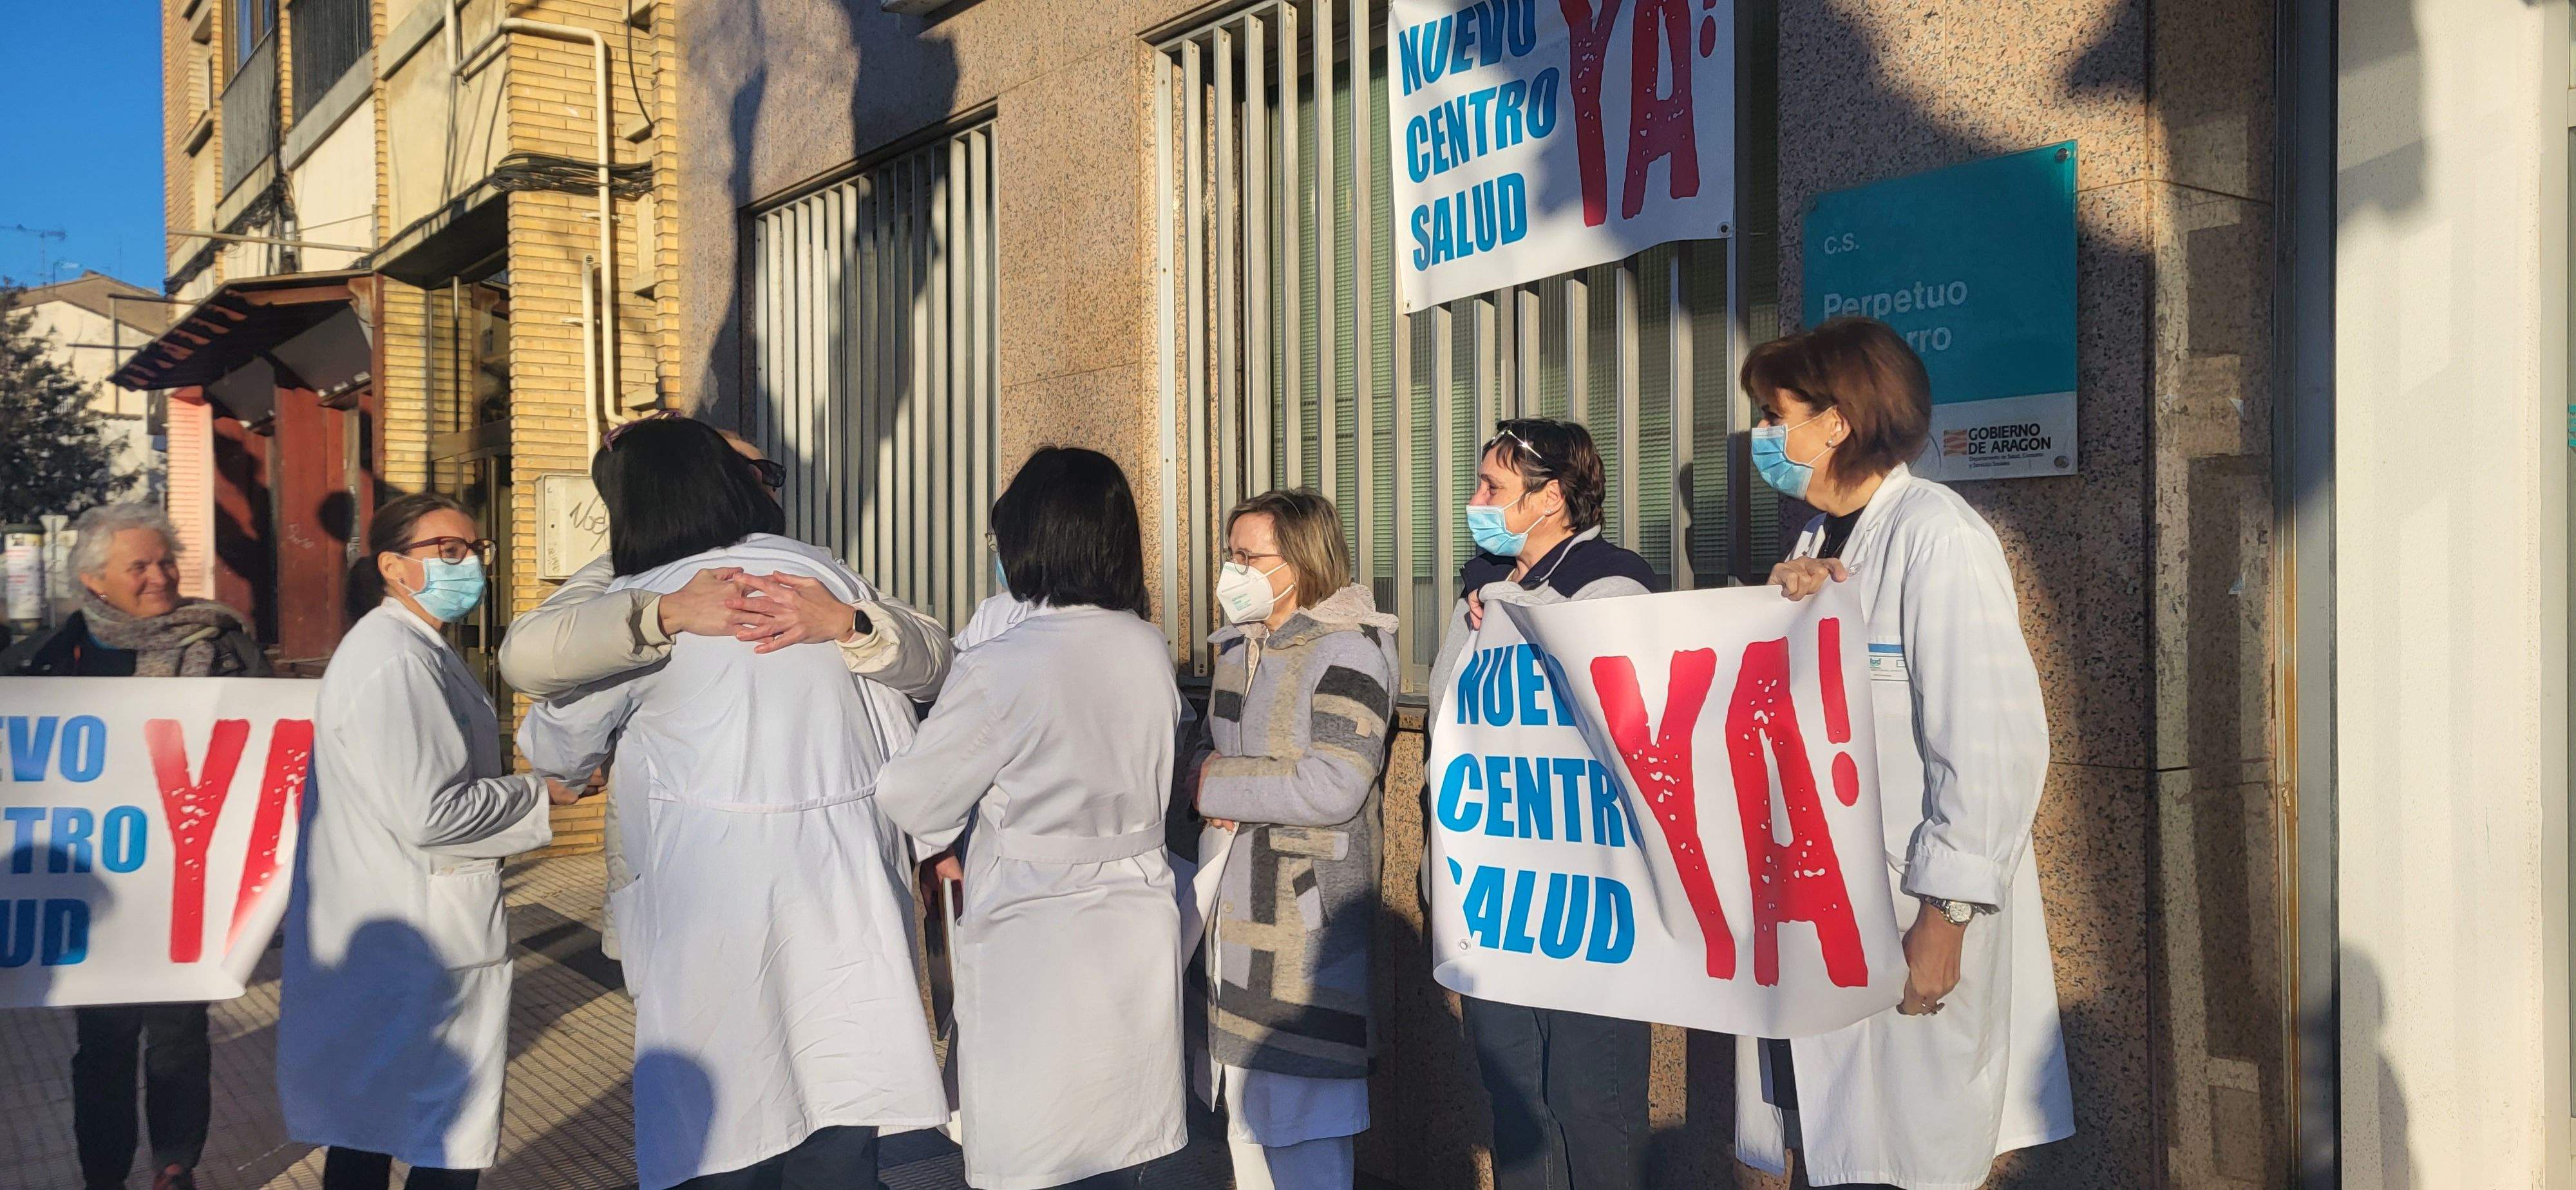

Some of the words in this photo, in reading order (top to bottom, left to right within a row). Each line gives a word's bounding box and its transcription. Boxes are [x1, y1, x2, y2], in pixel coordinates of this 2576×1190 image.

[1399, 0, 1537, 96] NUEVO
[1406, 67, 1560, 184] CENTRO
[1410, 172, 1528, 272] SALUD
[1824, 232, 1860, 255] C.S.
[1824, 281, 1968, 321] Perpetuo
[1968, 423, 2041, 440] GOBIERNO
[1968, 442, 1986, 455] DE
[1991, 437, 2052, 453] ARAGON
[1590, 617, 1868, 988] YA!
